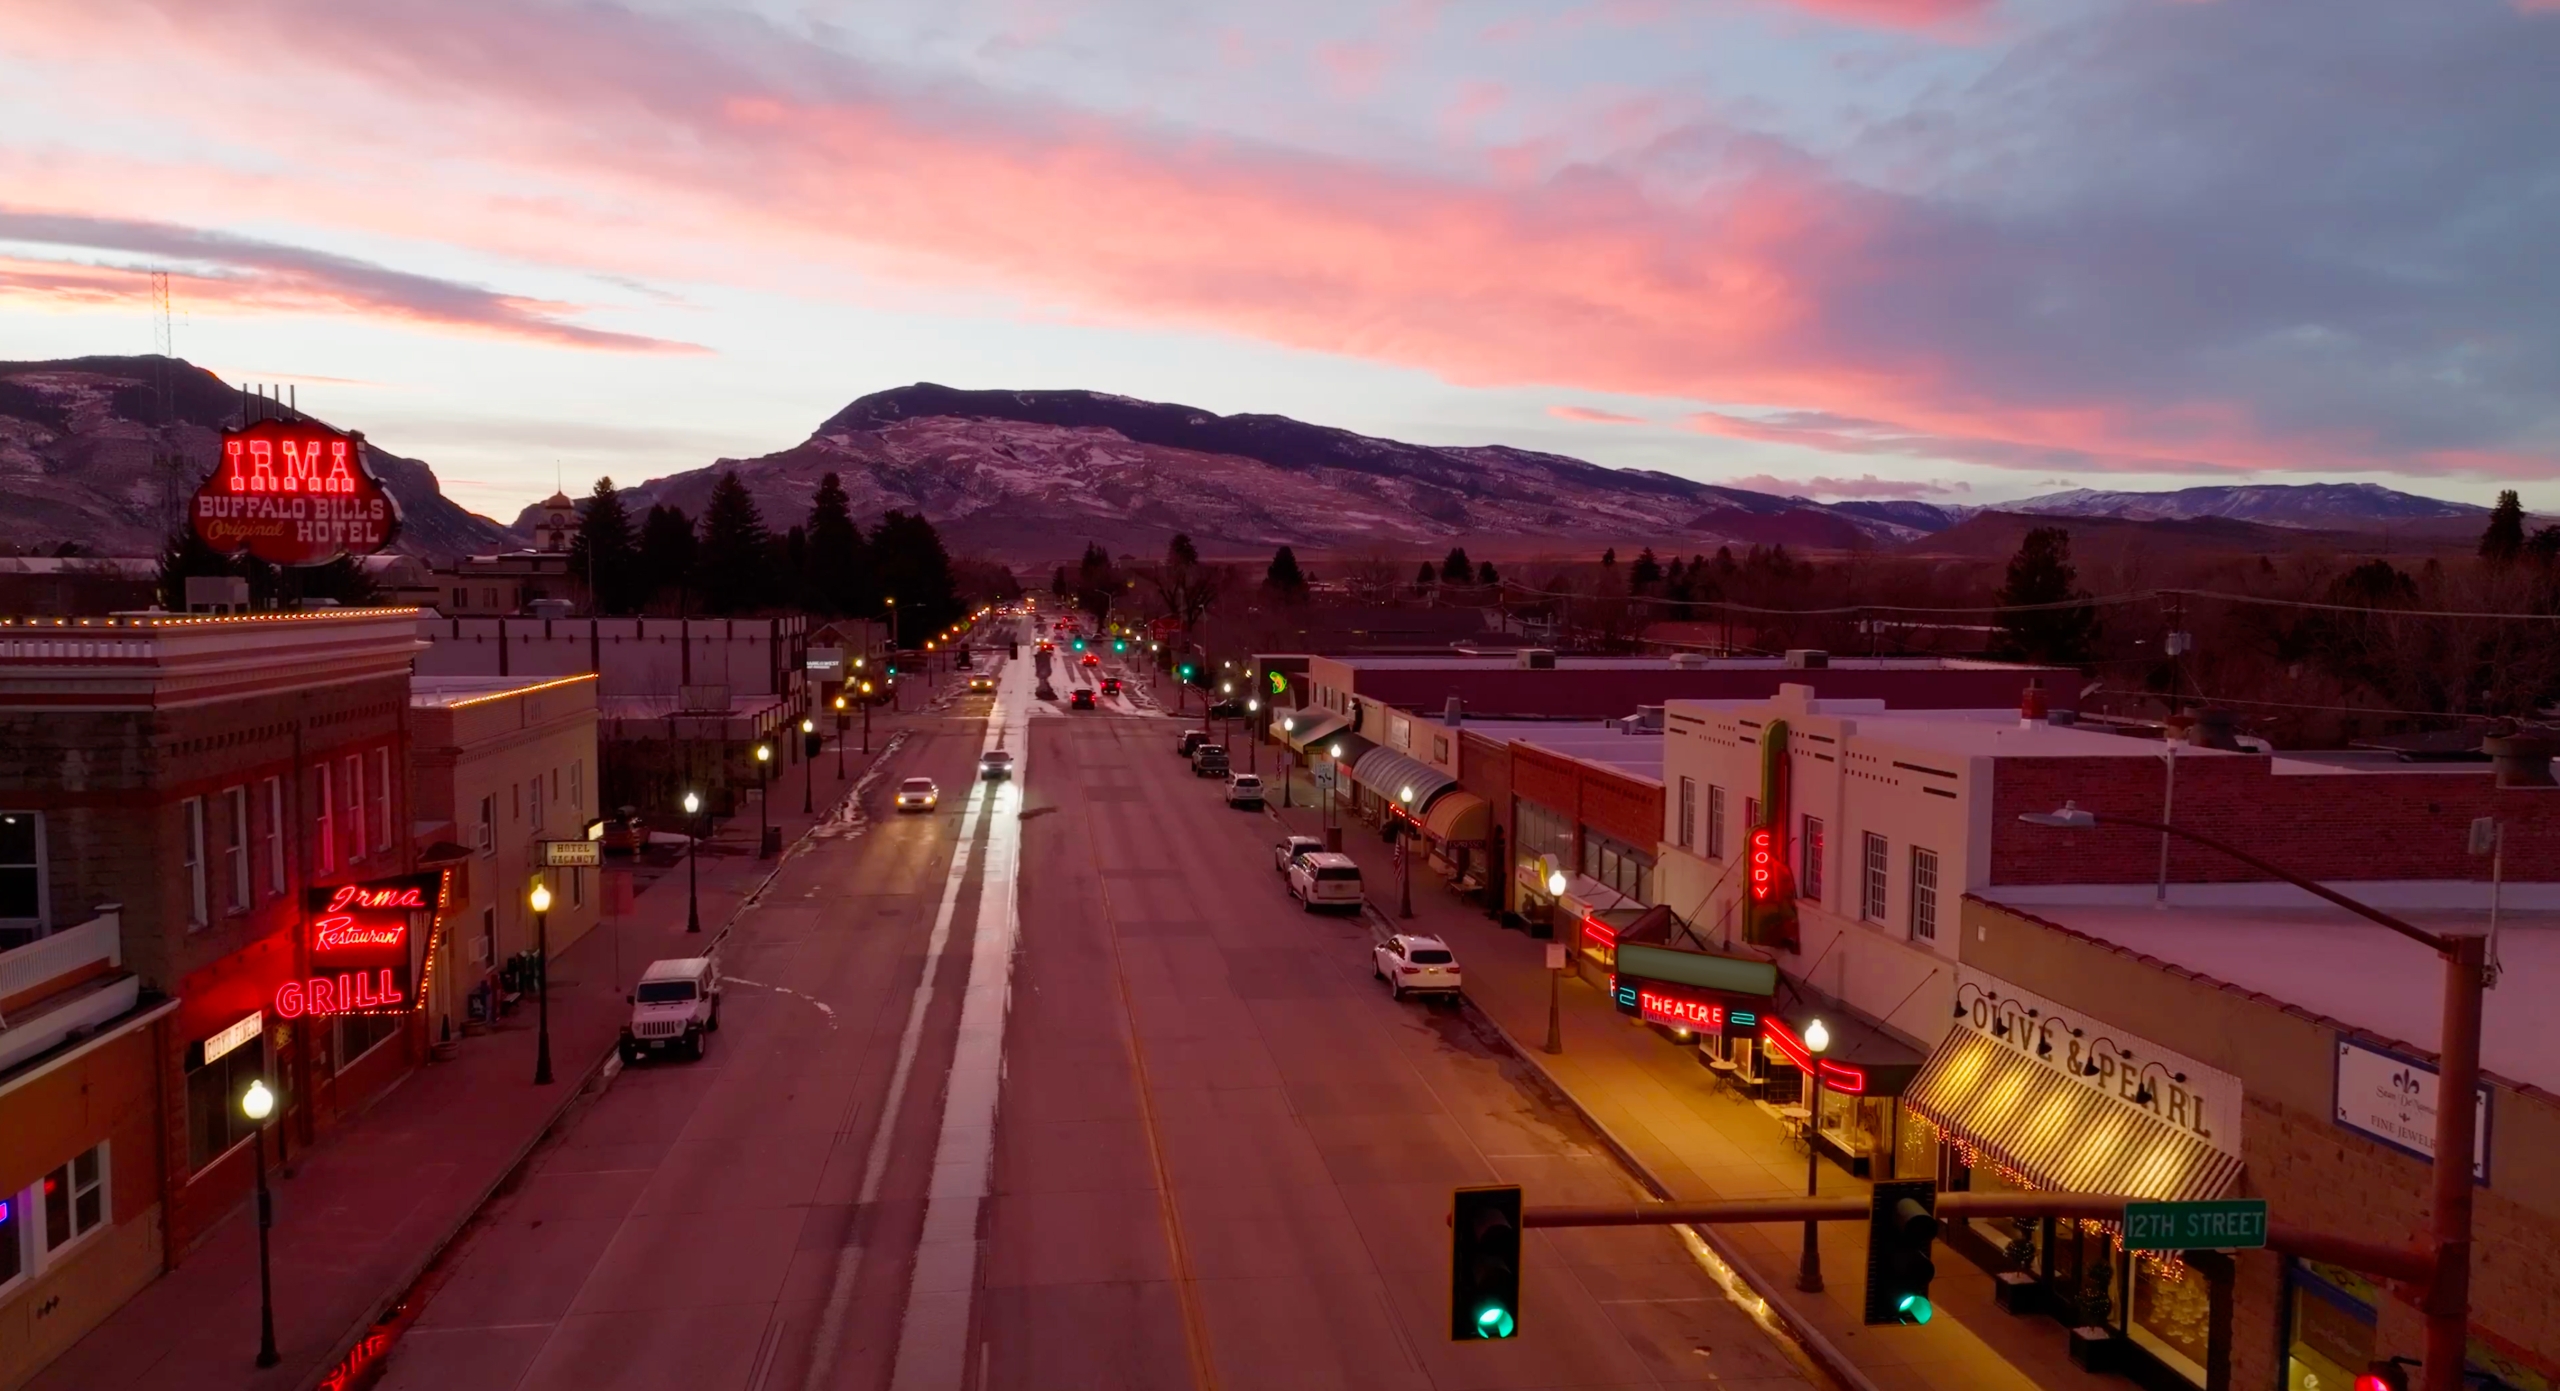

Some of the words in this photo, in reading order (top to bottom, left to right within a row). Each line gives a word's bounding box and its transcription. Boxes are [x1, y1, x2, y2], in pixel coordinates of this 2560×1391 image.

[227, 440, 354, 492] IRMA
[199, 496, 305, 518] BUFFALO
[314, 498, 384, 520] BILLS
[207, 519, 284, 541] Original
[296, 522, 379, 543] HOTEL
[551, 854, 596, 865] VACANCY
[557, 843, 590, 853] HOTEL
[1755, 834, 1769, 898] CODY
[327, 885, 424, 912] Irma
[315, 915, 404, 950] Restaurant
[276, 969, 401, 1018] GRILL
[1642, 993, 1722, 1023] THEATRE
[2067, 1040, 2083, 1078] &
[2098, 1053, 2212, 1139] PEARL
[2376, 1085, 2397, 1100] Sean
[2371, 1114, 2396, 1134] FINE
[2127, 1214, 2175, 1238] 12TH
[2187, 1211, 2264, 1237] STREET
